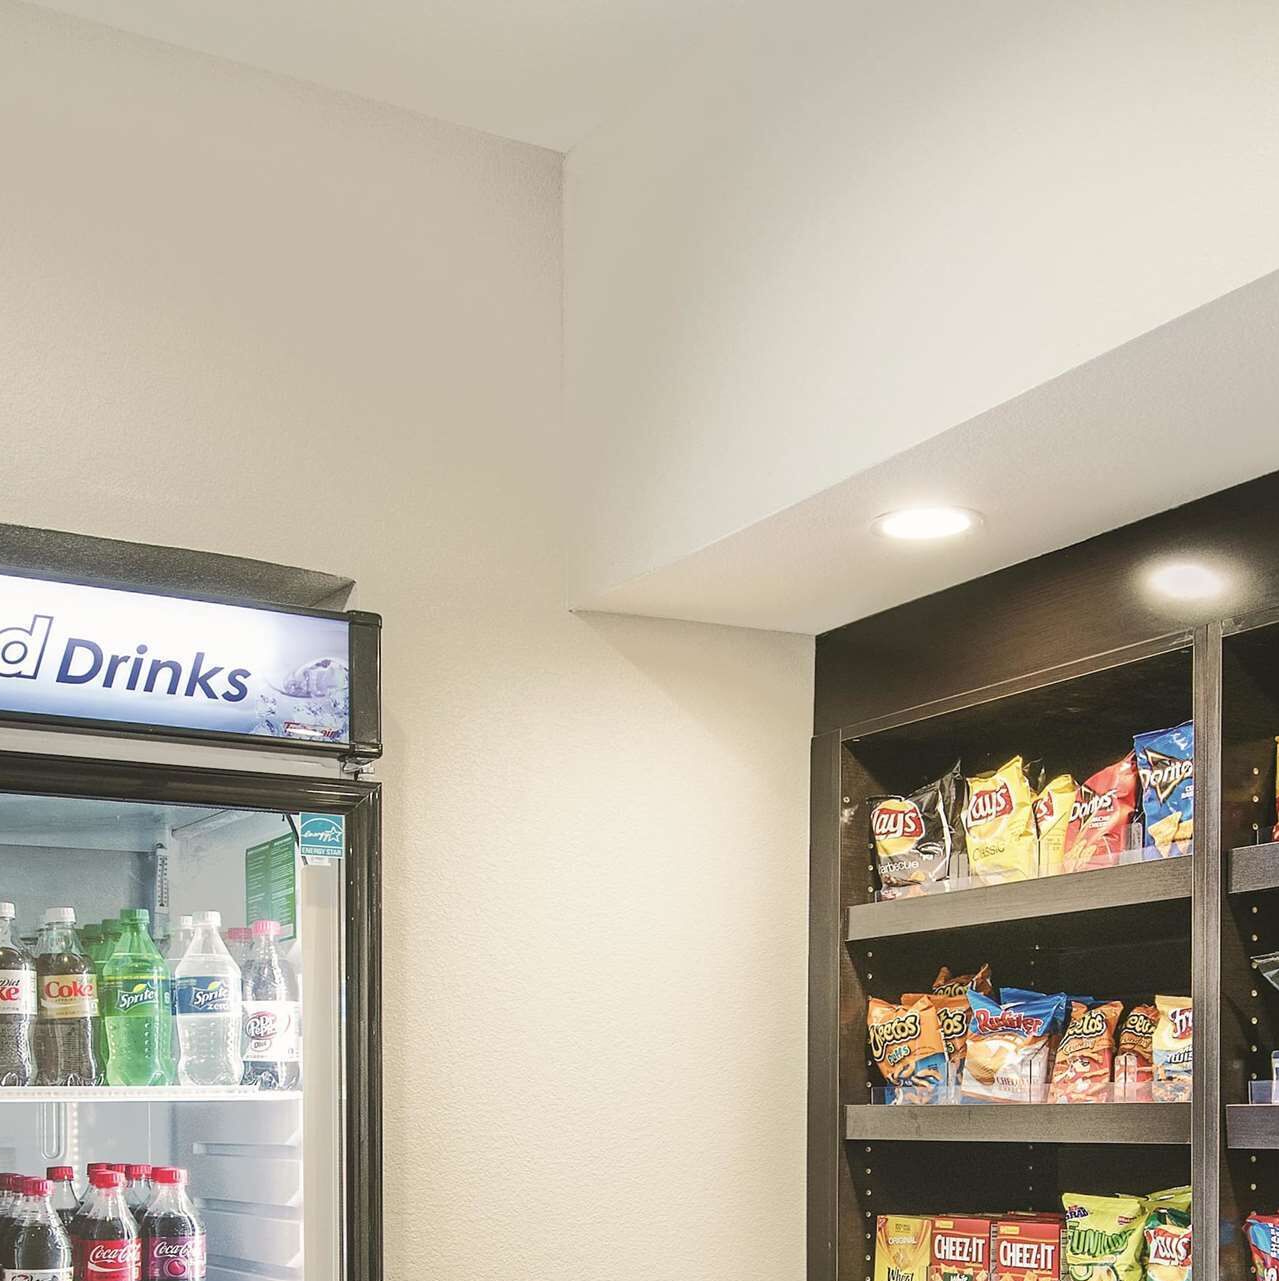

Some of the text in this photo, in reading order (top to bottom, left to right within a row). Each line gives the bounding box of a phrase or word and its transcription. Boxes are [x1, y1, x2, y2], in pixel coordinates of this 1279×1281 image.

[56, 640, 250, 703] Drinks
[967, 781, 1012, 825] Lay's
[1071, 790, 1119, 820] Doritos
[302, 847, 342, 856] ENERGY STAR
[44, 981, 95, 999] Coke
[119, 984, 158, 1009] Sprite
[194, 987, 231, 1007] Sprite
[869, 1013, 919, 1057] Cheetos
[888, 1236, 918, 1246] ORIGINAL
[934, 1234, 987, 1264] CHEEZ-IT
[999, 1240, 1056, 1270] CHEEZ-IT
[1148, 1229, 1192, 1266] Lay's
